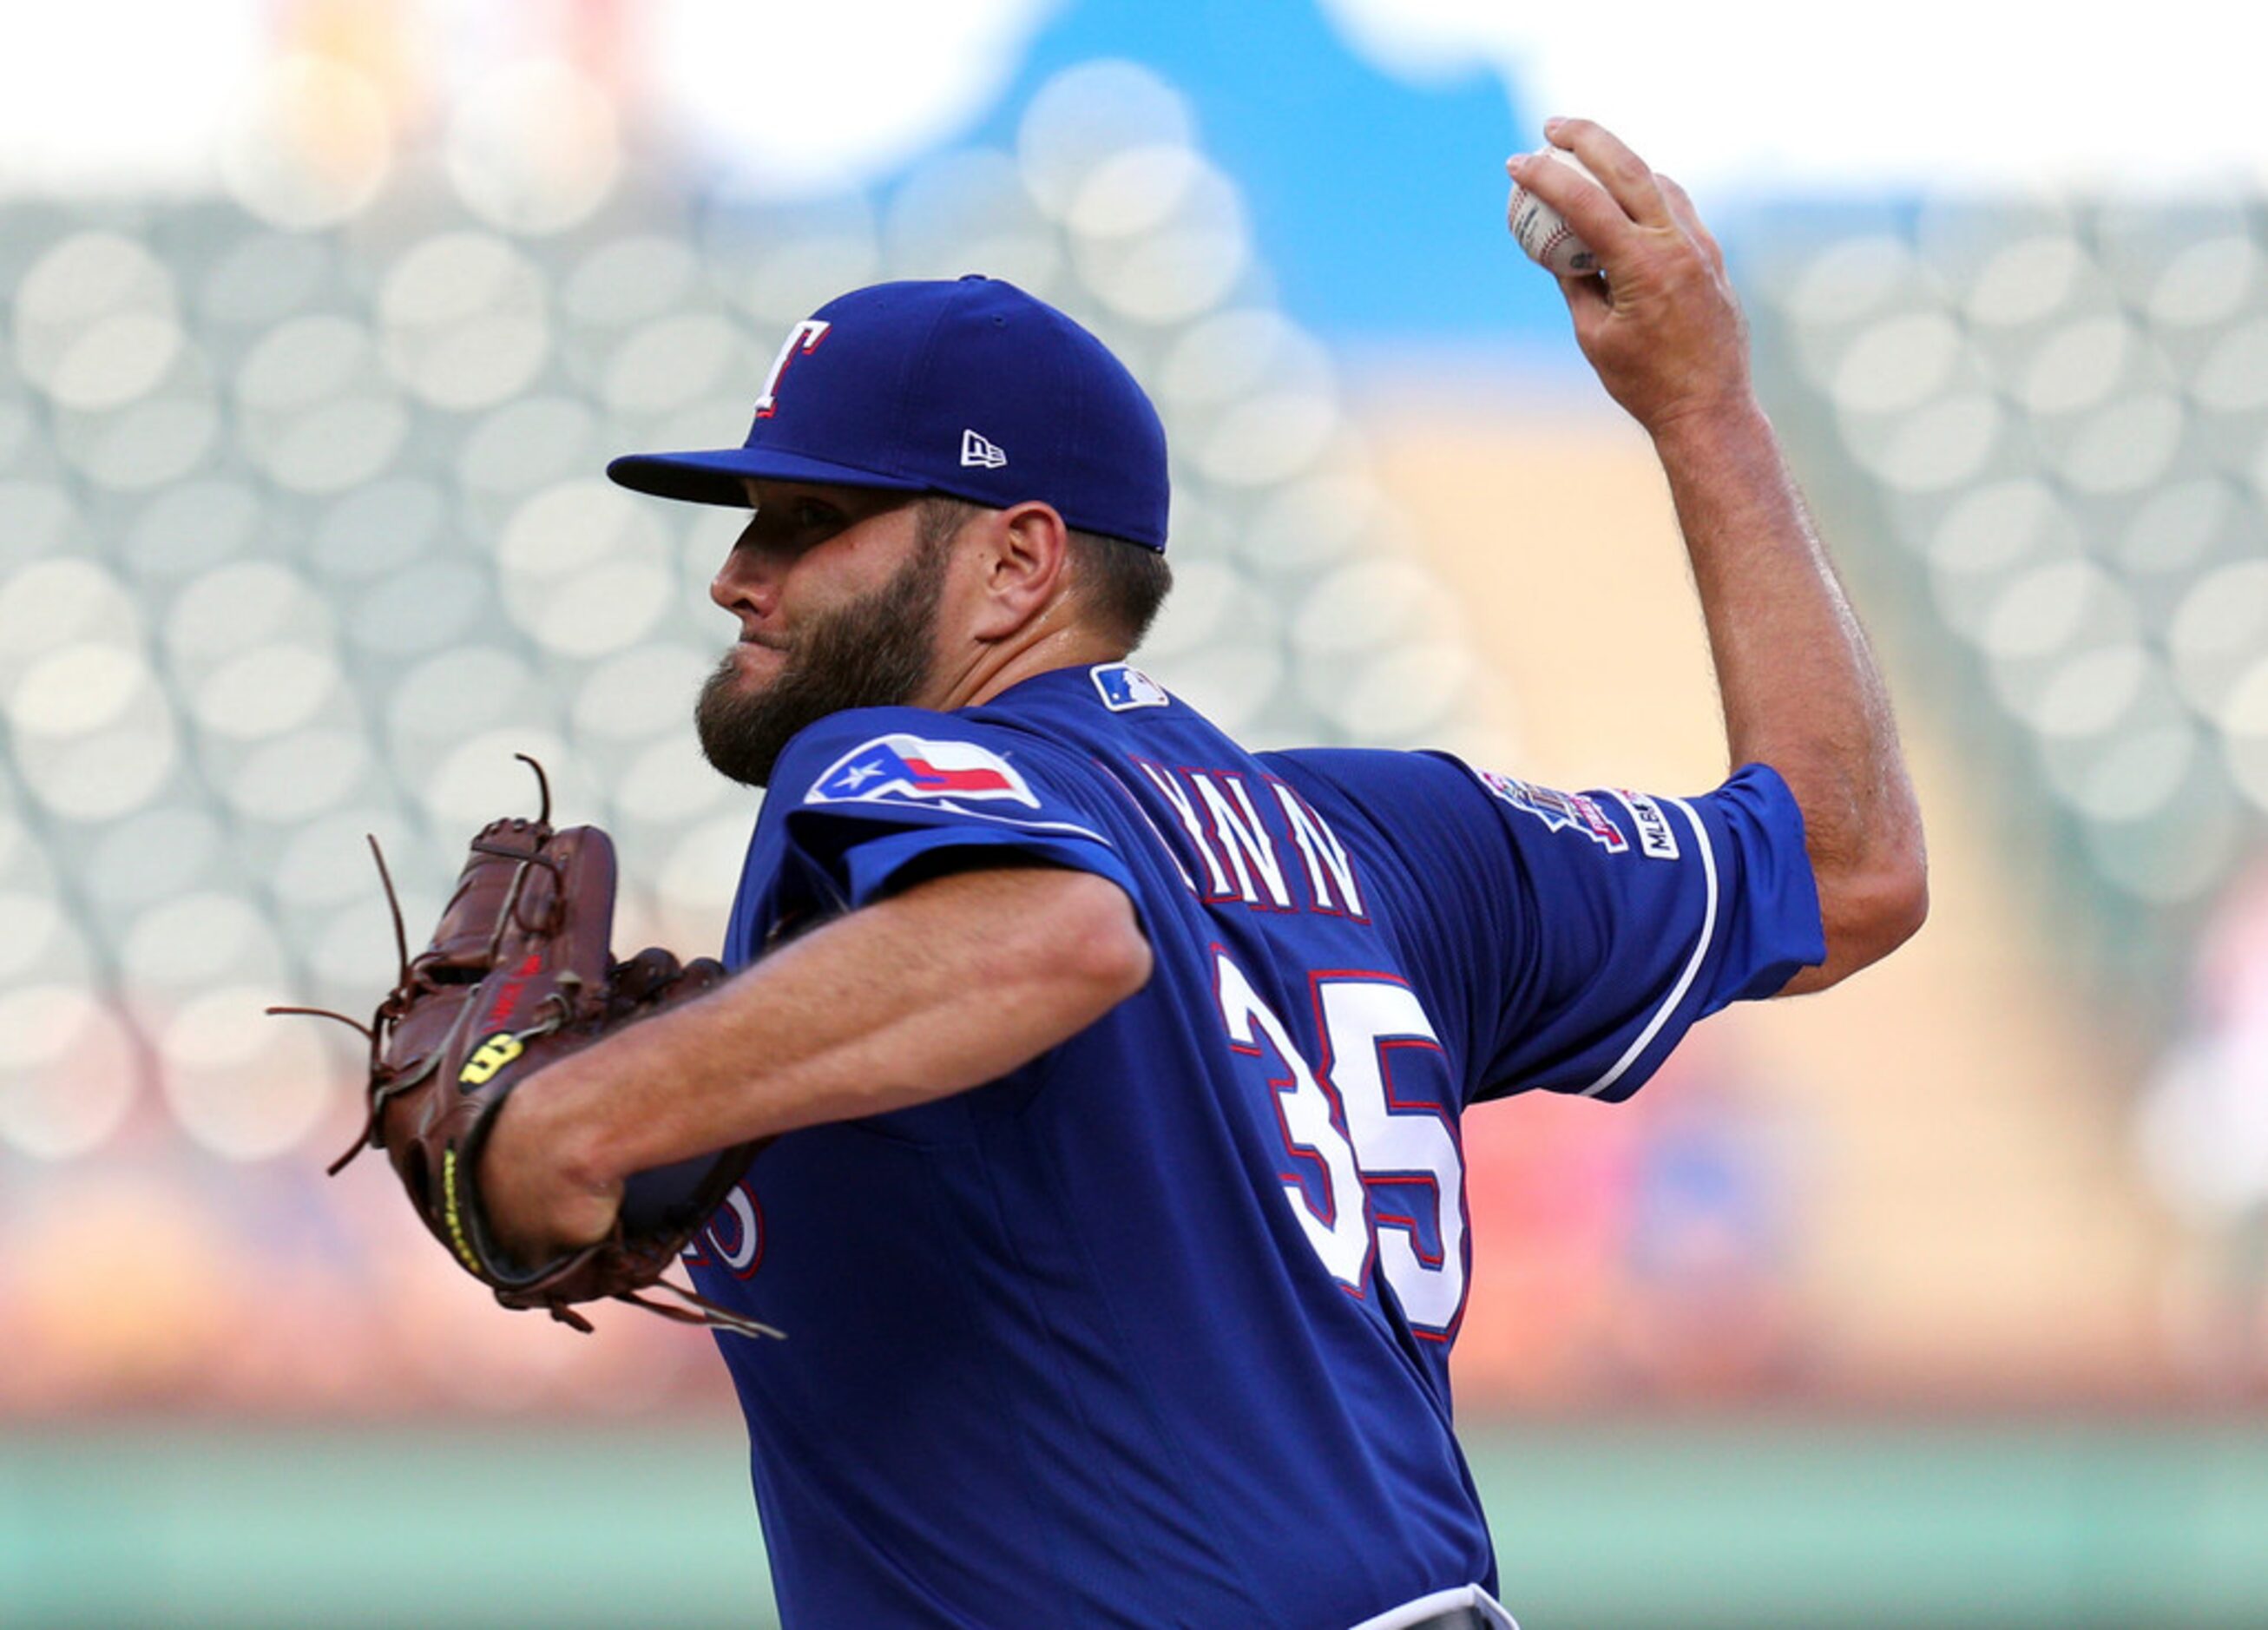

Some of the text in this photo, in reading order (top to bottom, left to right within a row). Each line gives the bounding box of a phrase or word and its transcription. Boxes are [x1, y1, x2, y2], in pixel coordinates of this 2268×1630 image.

[754, 319, 832, 418] T
[1092, 753, 1372, 926] YNN
[1210, 942, 1473, 1342] 35
